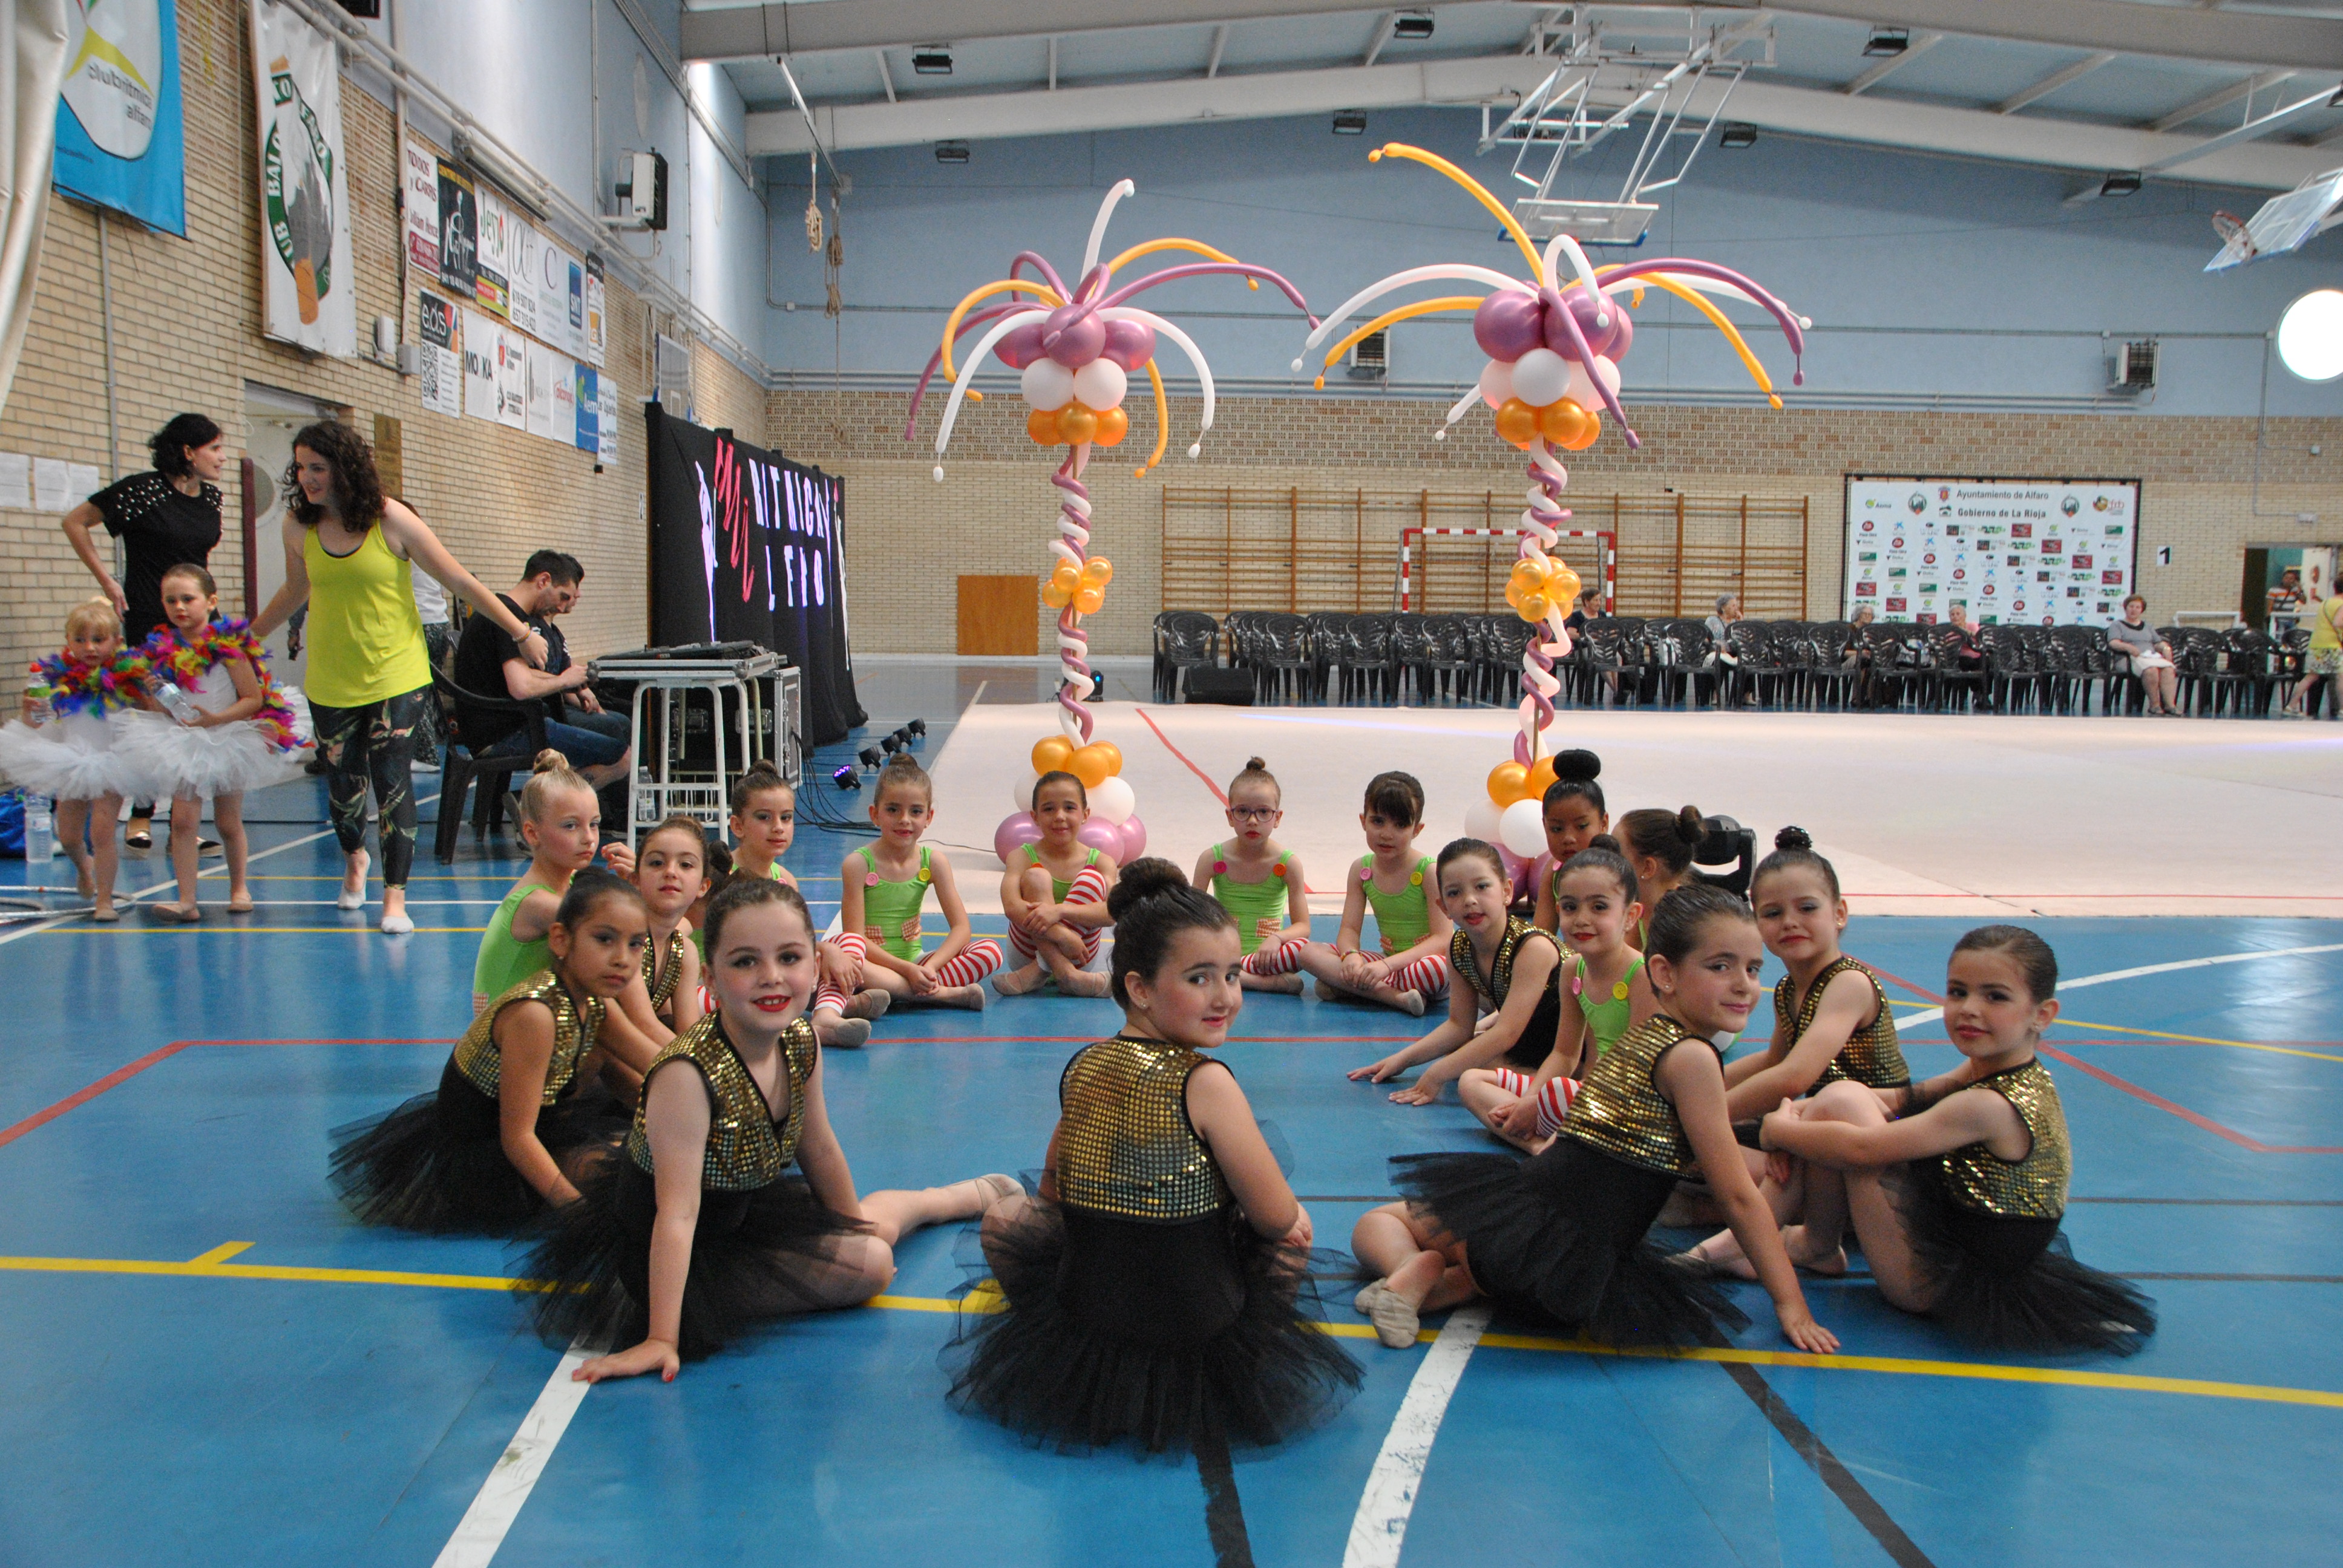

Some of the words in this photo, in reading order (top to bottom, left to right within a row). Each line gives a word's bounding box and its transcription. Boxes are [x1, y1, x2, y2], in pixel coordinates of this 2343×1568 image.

[1957, 490, 2011, 500] Ayuntamiento
[2025, 491, 2048, 499] Alfaro
[1958, 508, 1996, 517] Gobierno
[1999, 509, 2008, 517] de
[2024, 509, 2046, 519] Rioja
